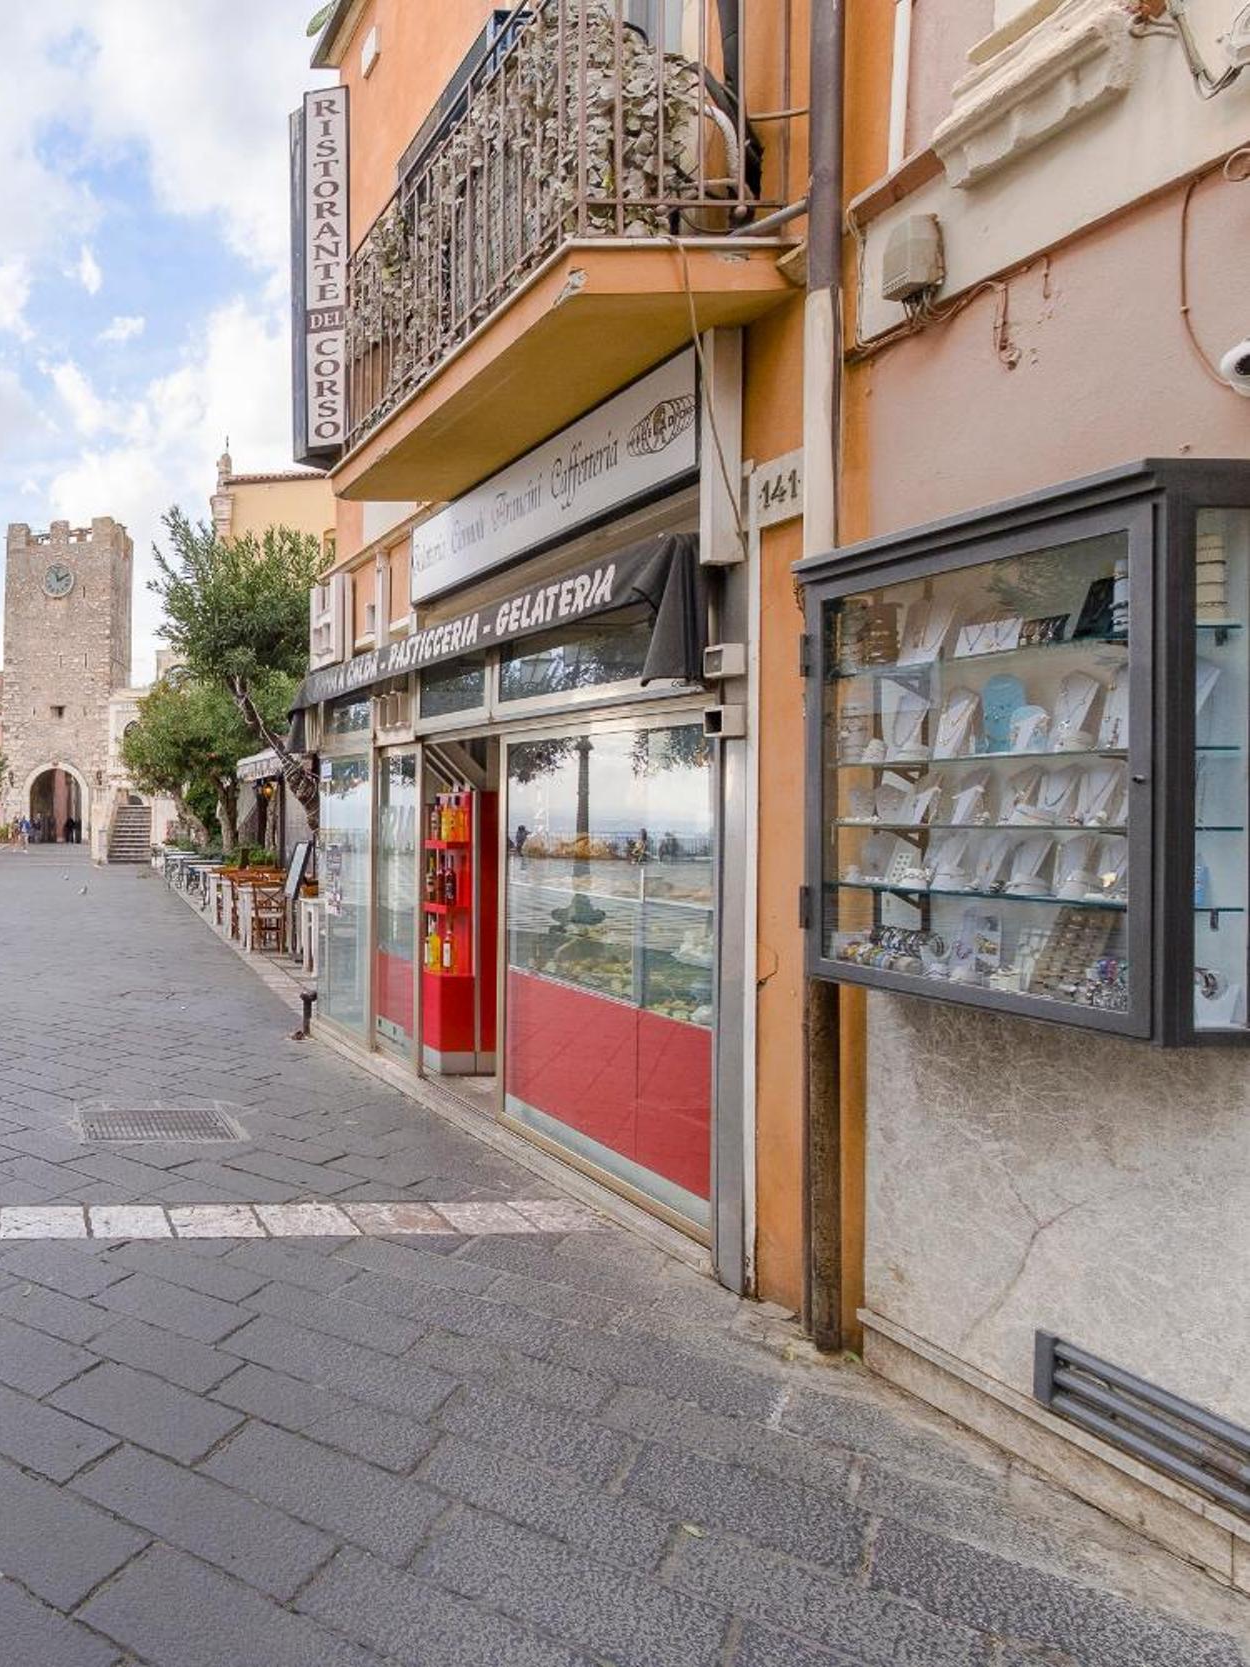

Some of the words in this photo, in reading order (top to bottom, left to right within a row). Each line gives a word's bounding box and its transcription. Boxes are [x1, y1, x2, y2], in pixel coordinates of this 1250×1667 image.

[313, 99, 342, 301] RISTORANTE
[310, 310, 341, 330] DEL
[314, 338, 341, 439] CORSO
[550, 431, 619, 511] Caffetteria
[387, 612, 480, 671] PASTICCERIA
[495, 563, 616, 637] GELATERIA
